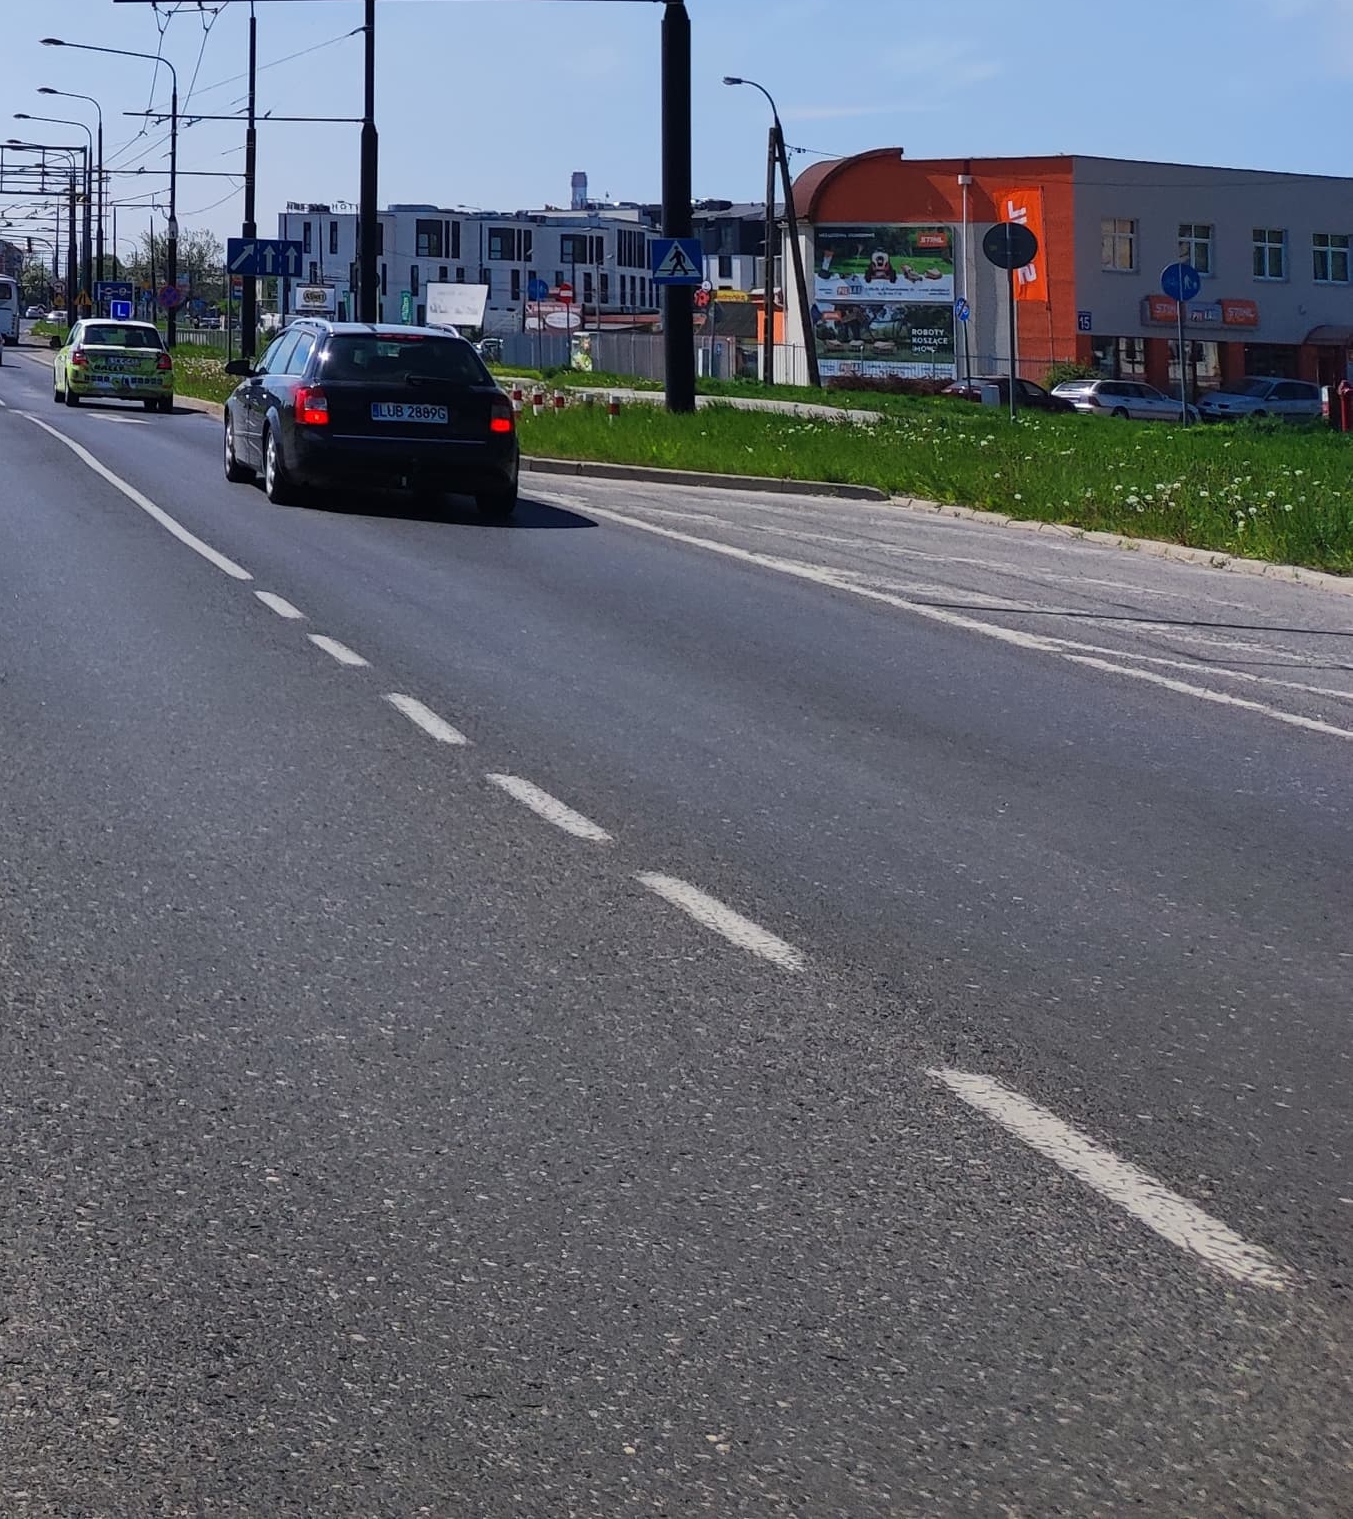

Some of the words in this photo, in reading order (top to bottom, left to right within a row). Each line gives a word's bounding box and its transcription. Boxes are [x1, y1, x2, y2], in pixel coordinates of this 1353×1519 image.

[117, 304, 126, 317] L
[1079, 316, 1090, 329] 15
[912, 328, 945, 336] ROBOTY
[912, 337, 948, 346] KOSZĄCE
[379, 405, 403, 418] LUB
[407, 406, 446, 420] 2889G
